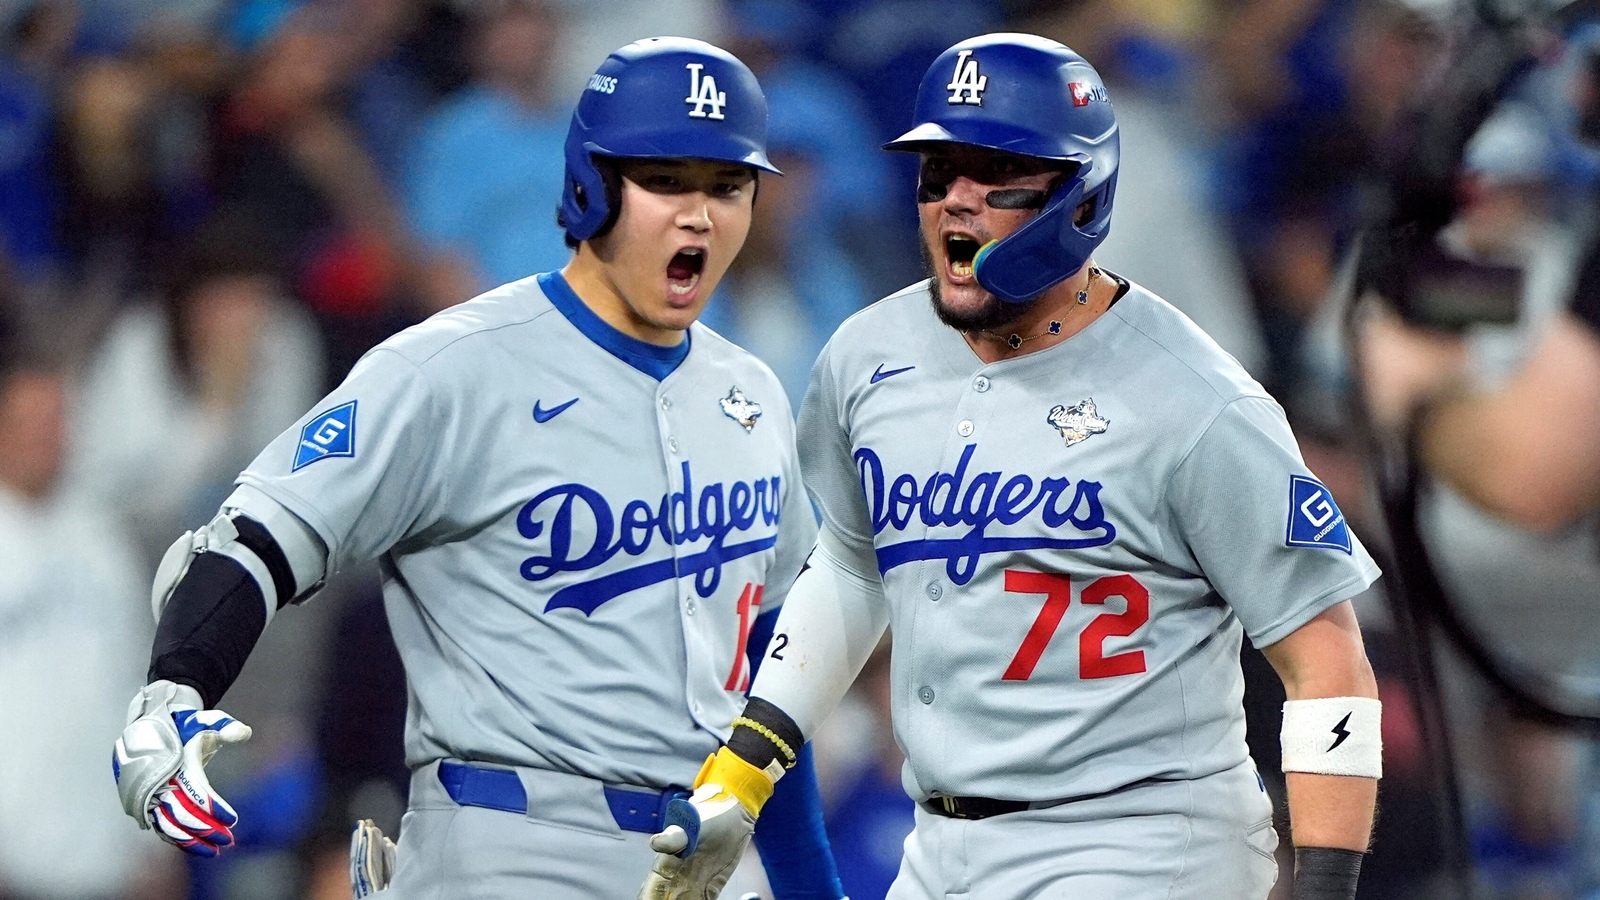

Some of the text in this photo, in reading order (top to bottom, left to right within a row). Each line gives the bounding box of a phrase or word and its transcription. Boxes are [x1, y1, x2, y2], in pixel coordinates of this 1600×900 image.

[685, 63, 726, 120] LA
[947, 50, 988, 106] LA
[313, 417, 346, 445] G
[516, 460, 780, 599] Dodgers
[854, 443, 1116, 586] Dodgers
[1300, 489, 1334, 528] G
[770, 632, 789, 661] 2
[1001, 568, 1150, 681] 72
[178, 770, 205, 806] balance
